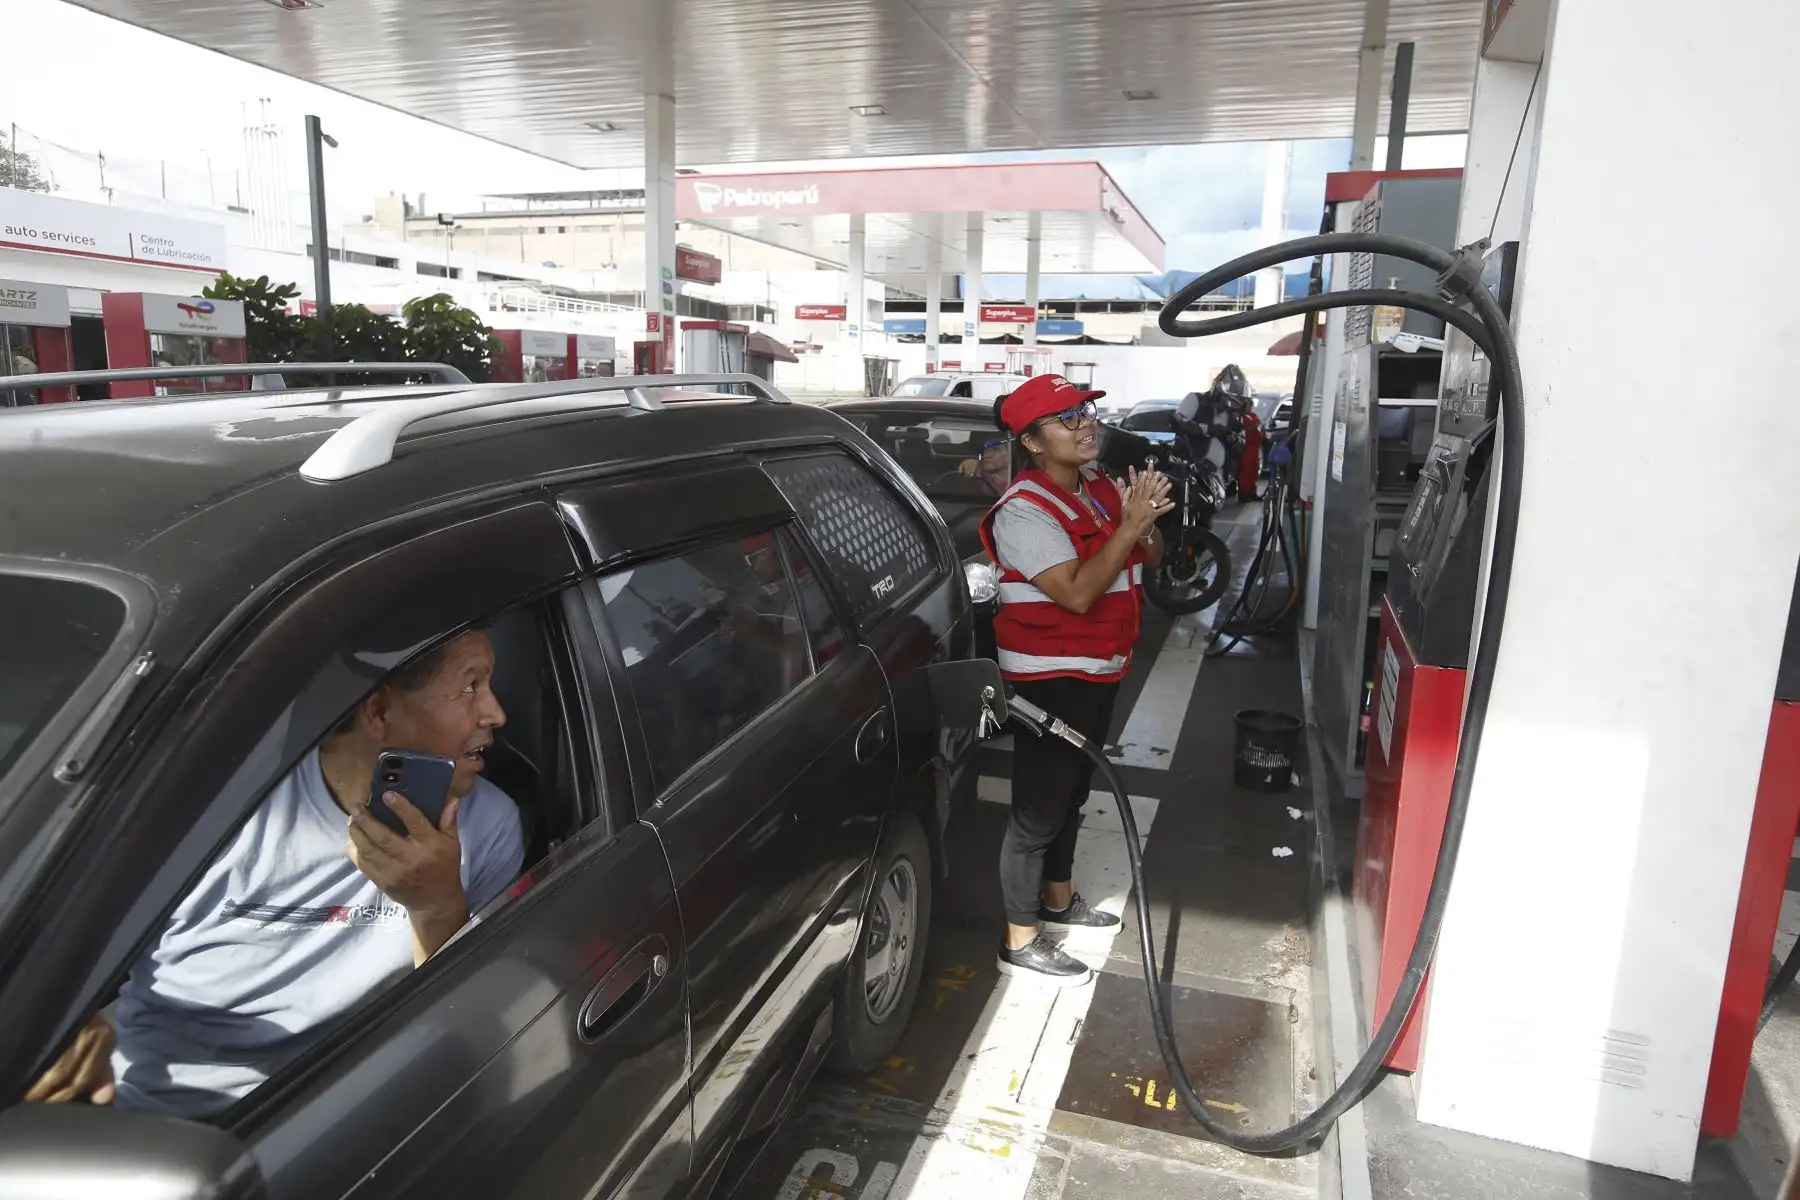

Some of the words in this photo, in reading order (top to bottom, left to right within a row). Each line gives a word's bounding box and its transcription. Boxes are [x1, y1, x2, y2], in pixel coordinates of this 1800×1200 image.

[723, 184, 819, 209] Petroperú
[5, 225, 37, 238] auto
[42, 231, 96, 246] services
[141, 234, 174, 247] Centro
[142, 246, 155, 255] de
[157, 247, 212, 262] Lubricación
[800, 307, 829, 315] Superplus
[985, 309, 1016, 317] Superplus
[871, 574, 895, 599] TRD
